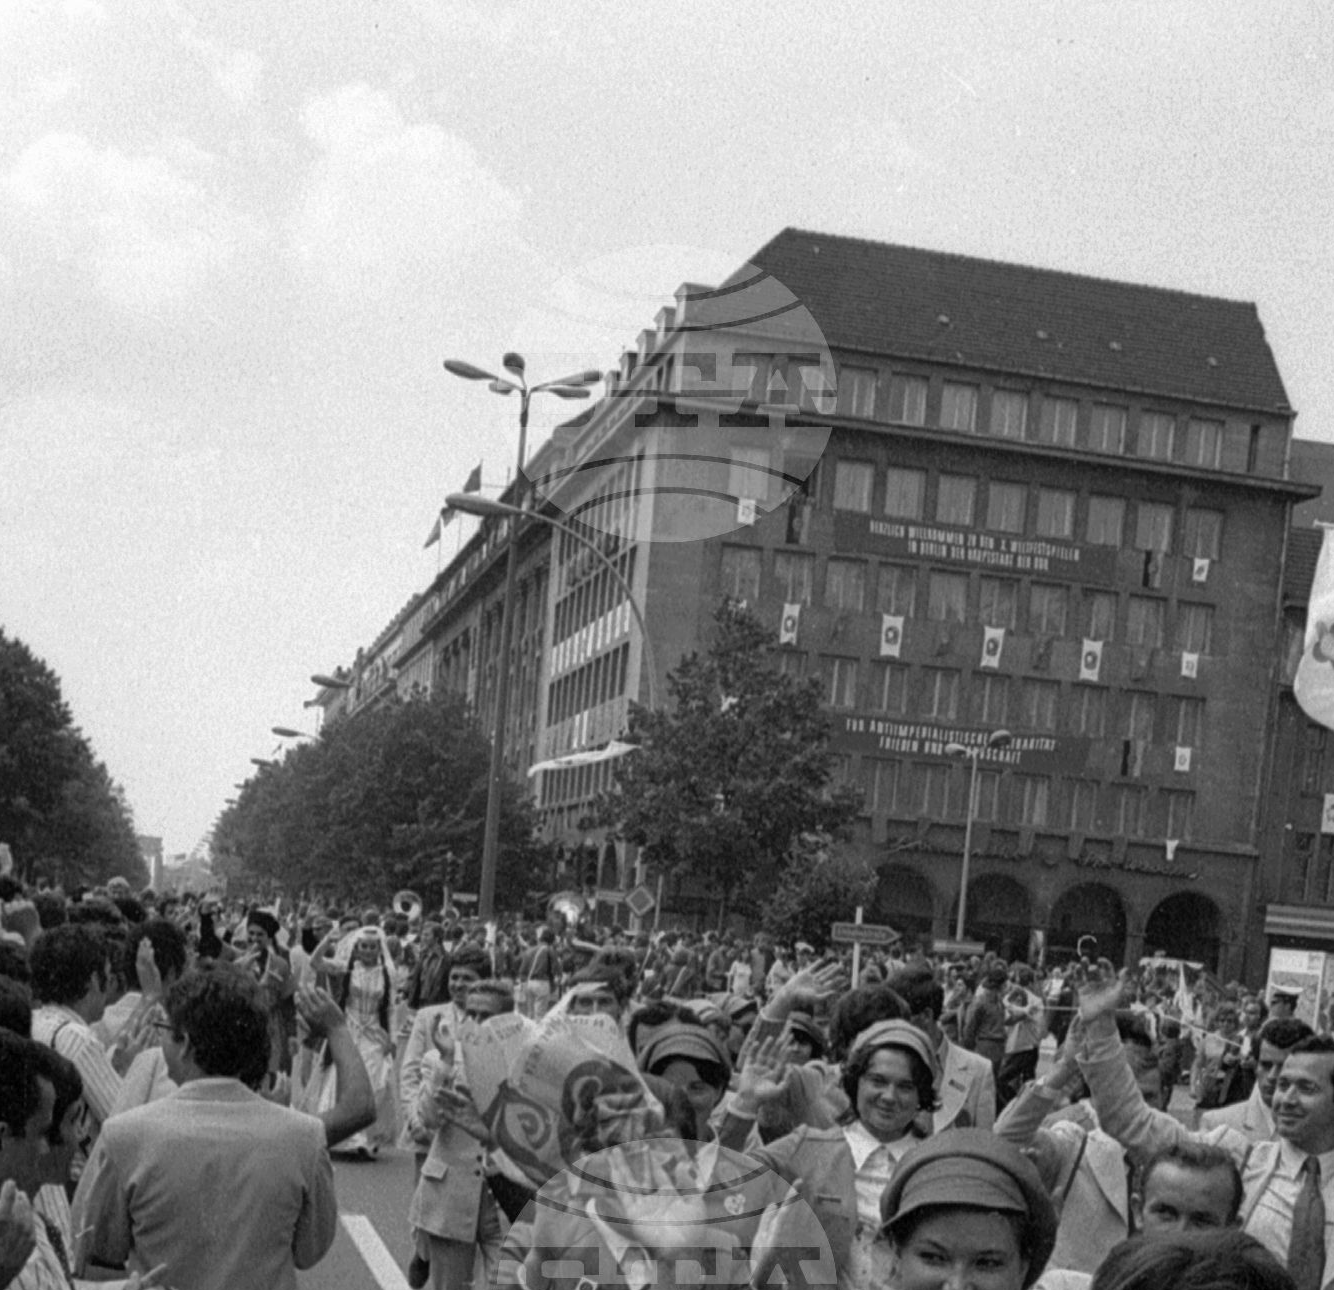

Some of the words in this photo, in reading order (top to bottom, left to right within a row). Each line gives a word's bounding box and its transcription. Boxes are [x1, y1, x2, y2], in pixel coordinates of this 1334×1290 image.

[908, 526, 964, 545] WILLKOMMEN
[920, 541, 947, 558] BERLIN
[879, 735, 918, 752] FRIEDEN
